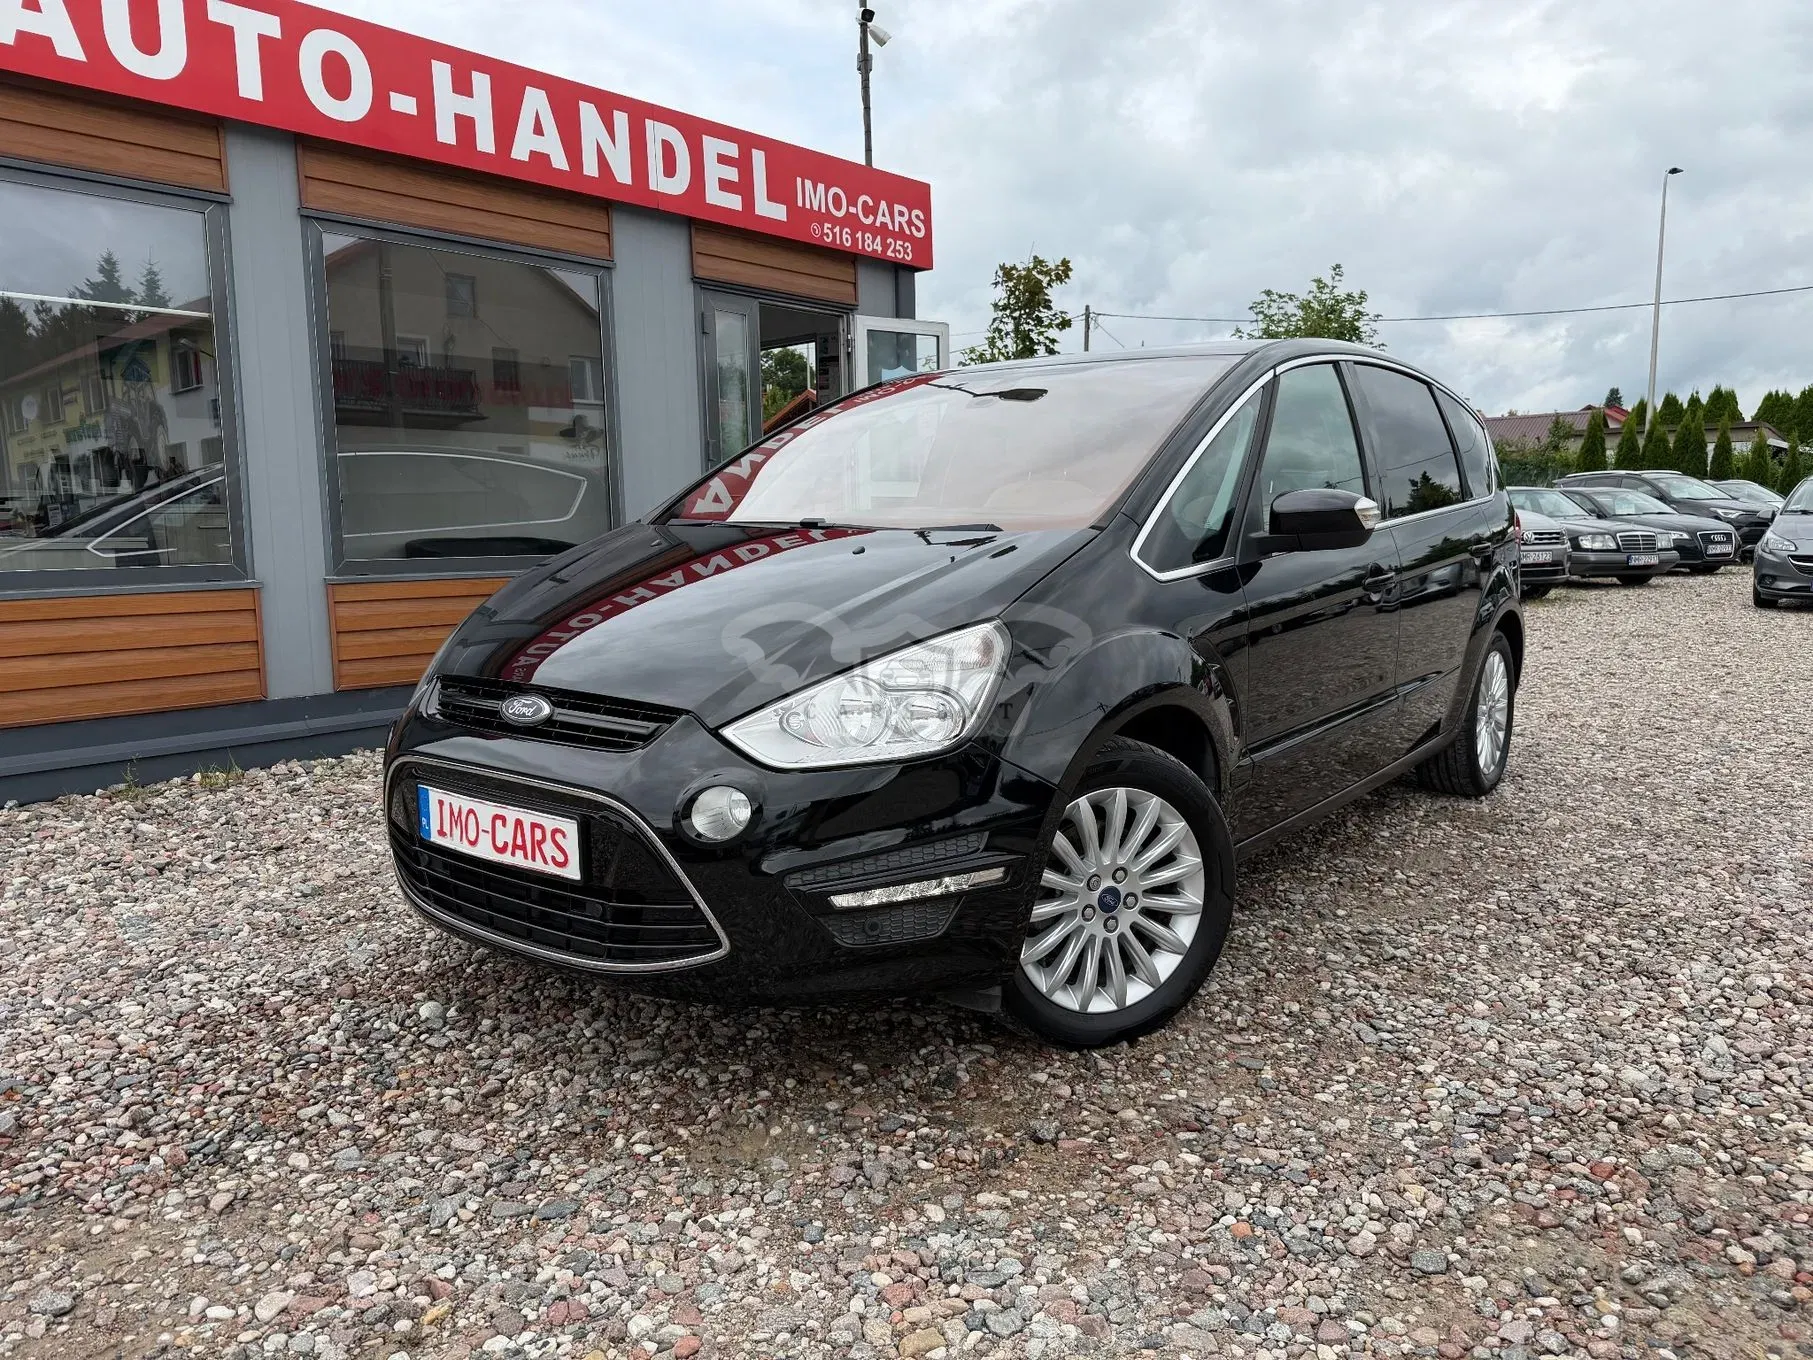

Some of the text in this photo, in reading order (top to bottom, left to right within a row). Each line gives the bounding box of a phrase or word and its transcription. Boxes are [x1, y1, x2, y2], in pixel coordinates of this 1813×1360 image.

[796, 176, 926, 238] IMO-CARS
[823, 222, 913, 261] 516 184 253
[508, 699, 537, 717] Ford
[436, 798, 570, 869] IMO-CARS
